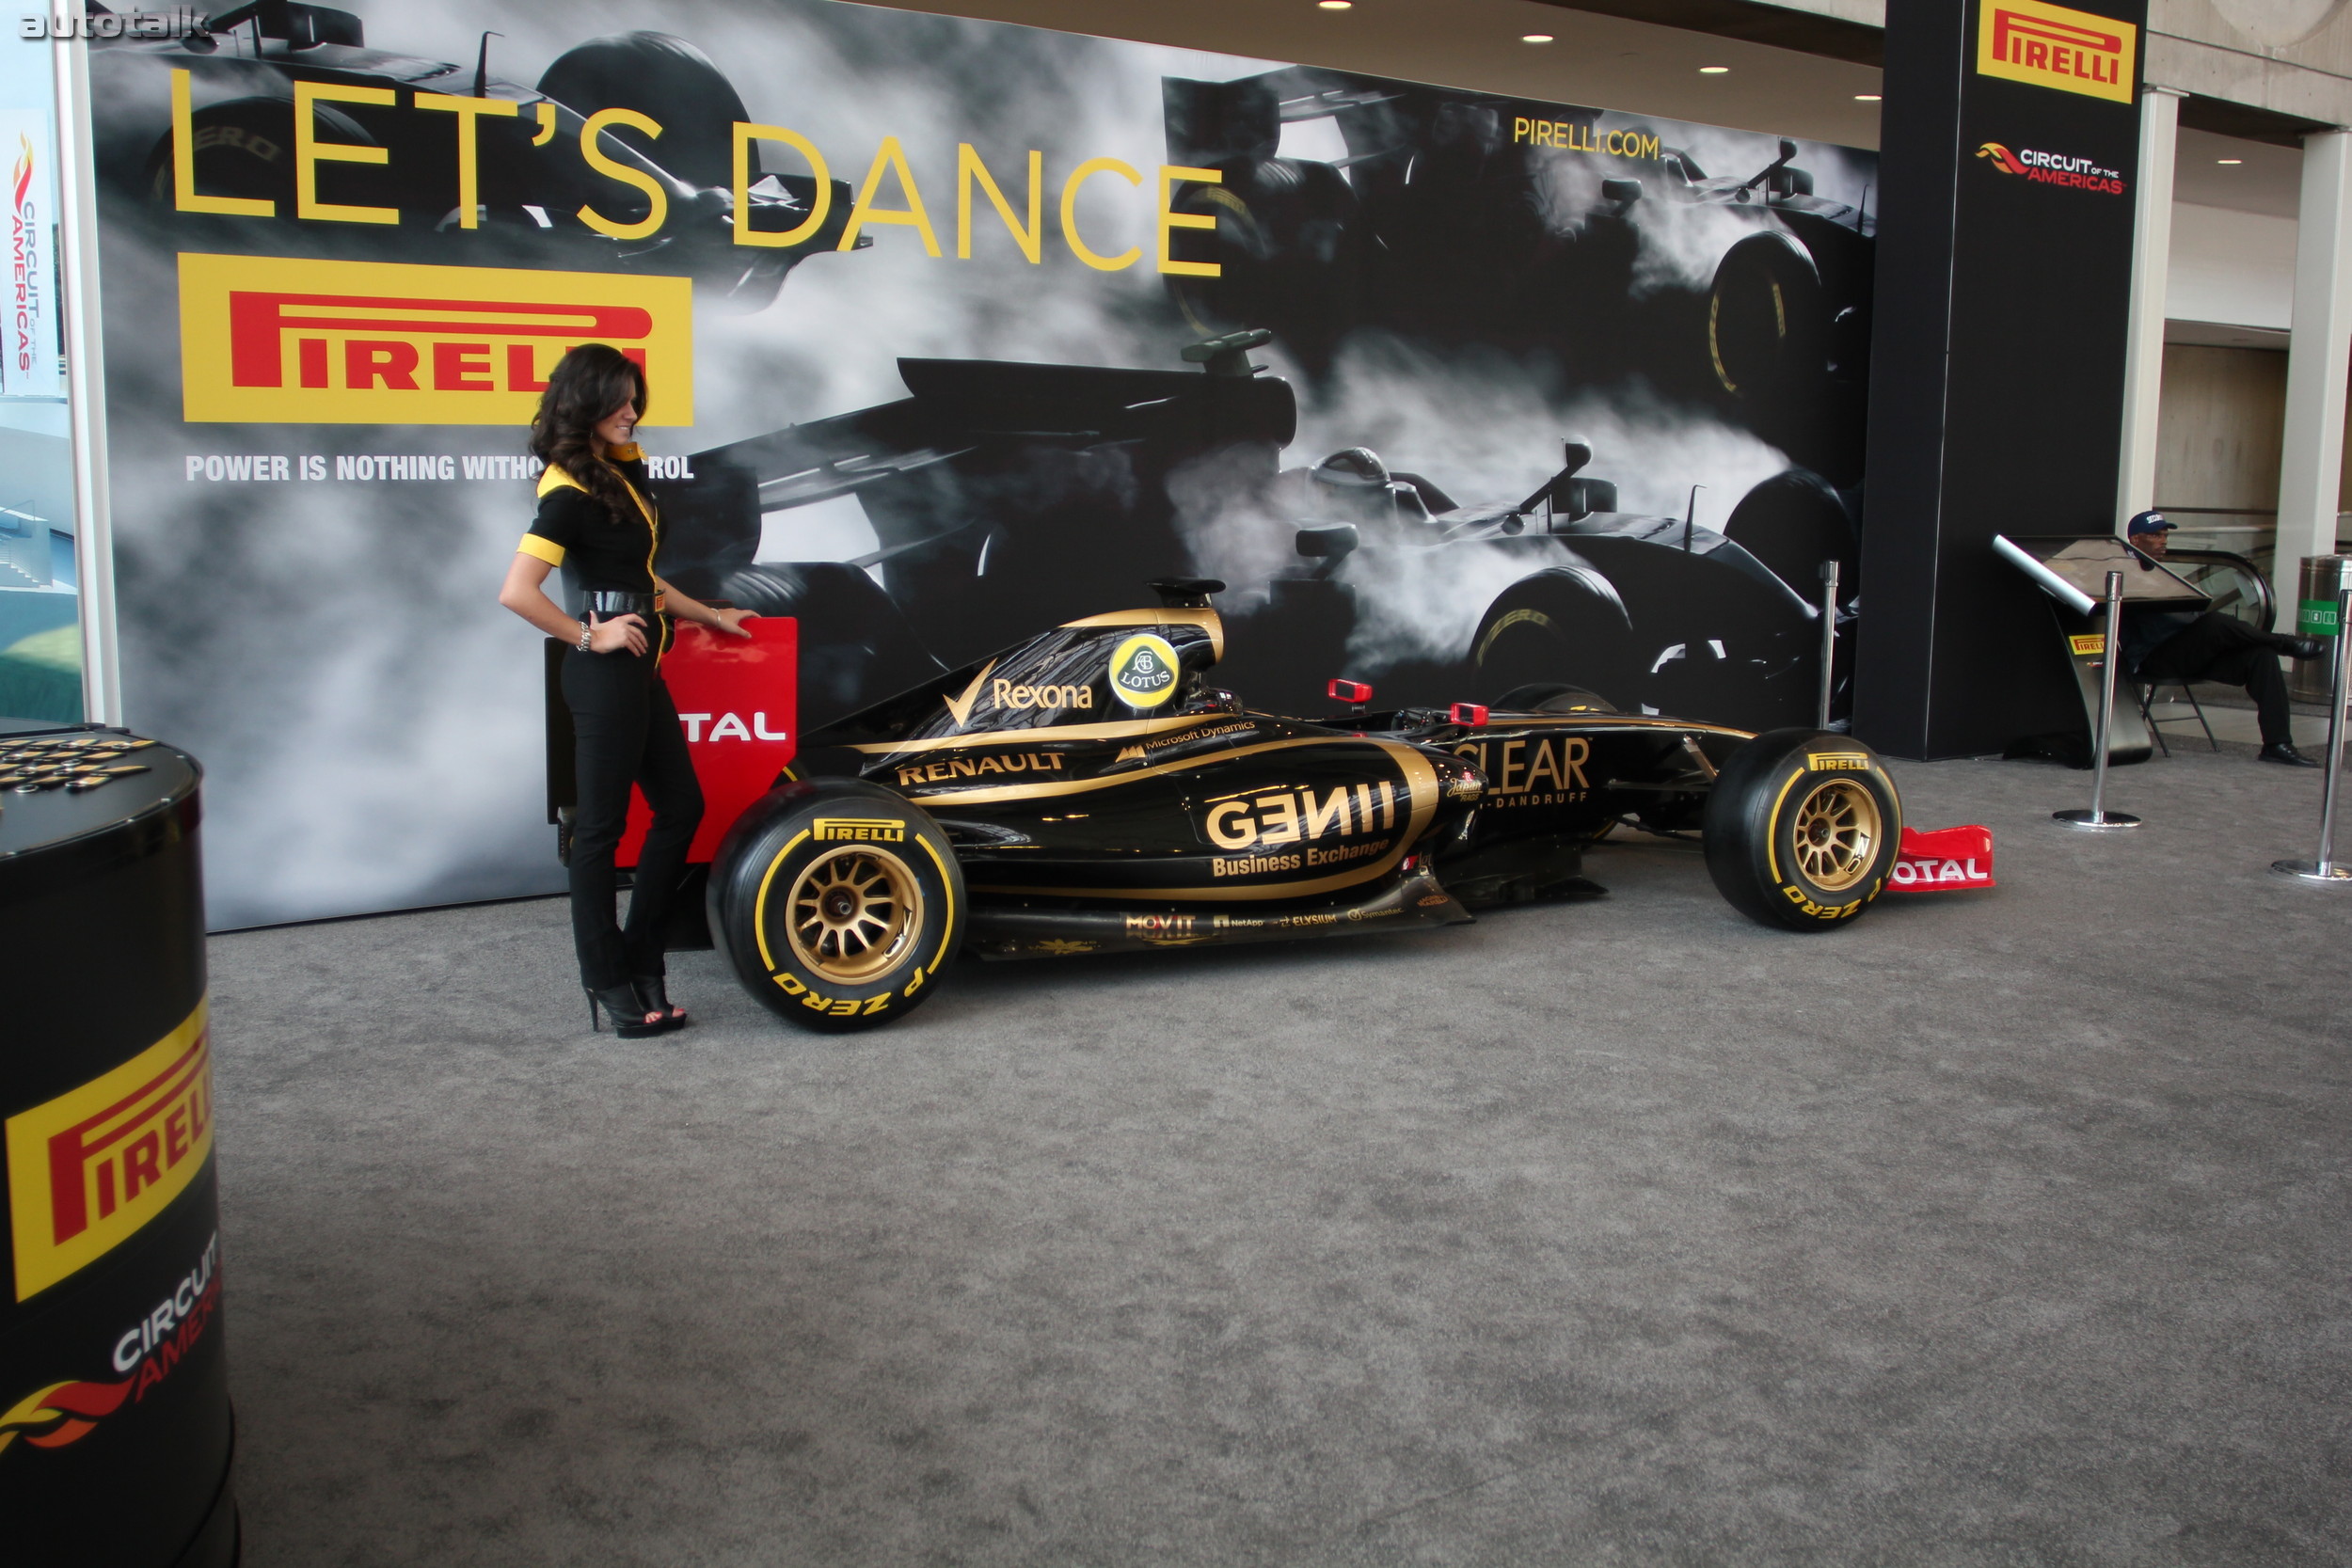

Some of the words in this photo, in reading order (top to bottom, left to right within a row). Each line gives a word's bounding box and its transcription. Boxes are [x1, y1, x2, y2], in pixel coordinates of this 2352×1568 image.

[1992, 8, 2122, 85] PIRELLI
[1514, 116, 1661, 161] PIRELLI.COM
[171, 68, 669, 242] LET'S
[732, 120, 1223, 278] DANCE
[2020, 149, 2092, 174] CIRCUIT
[2091, 166, 2103, 176] OF
[2104, 169, 2120, 179] THE
[2027, 168, 2124, 196] AMERICAS
[24, 201, 40, 318] CIRCUIT
[11, 214, 30, 372] AMERICAS
[230, 291, 653, 394] PIREL
[185, 455, 290, 482] POWER
[299, 455, 326, 482] IS
[336, 455, 455, 481] NOTHING
[462, 455, 544, 480] WITHO
[993, 678, 1092, 709] Rexona
[1120, 670, 1170, 689] LOTUS
[678, 711, 787, 743] TAL
[1145, 730, 1200, 751] Microsoft
[1200, 721, 1256, 739] Dynamics
[897, 752, 1065, 786] RENAULT
[1806, 752, 1869, 772] PIRELLI
[1446, 777, 1483, 798] Japan
[813, 817, 906, 844] PIRELLI
[1212, 854, 1301, 878] Business
[1307, 838, 1390, 867] Exchange
[1892, 858, 1988, 884] OTAL
[1231, 919, 1264, 927] NetApp
[1293, 913, 1337, 927] ELYSIUM
[1360, 907, 1405, 919] Symantec
[1782, 884, 1863, 920] ZERO
[771, 972, 892, 1016] ZERO
[903, 966, 924, 998] P
[48, 1021, 212, 1247] PIRELL
[112, 1229, 217, 1373] CIRCUIT
